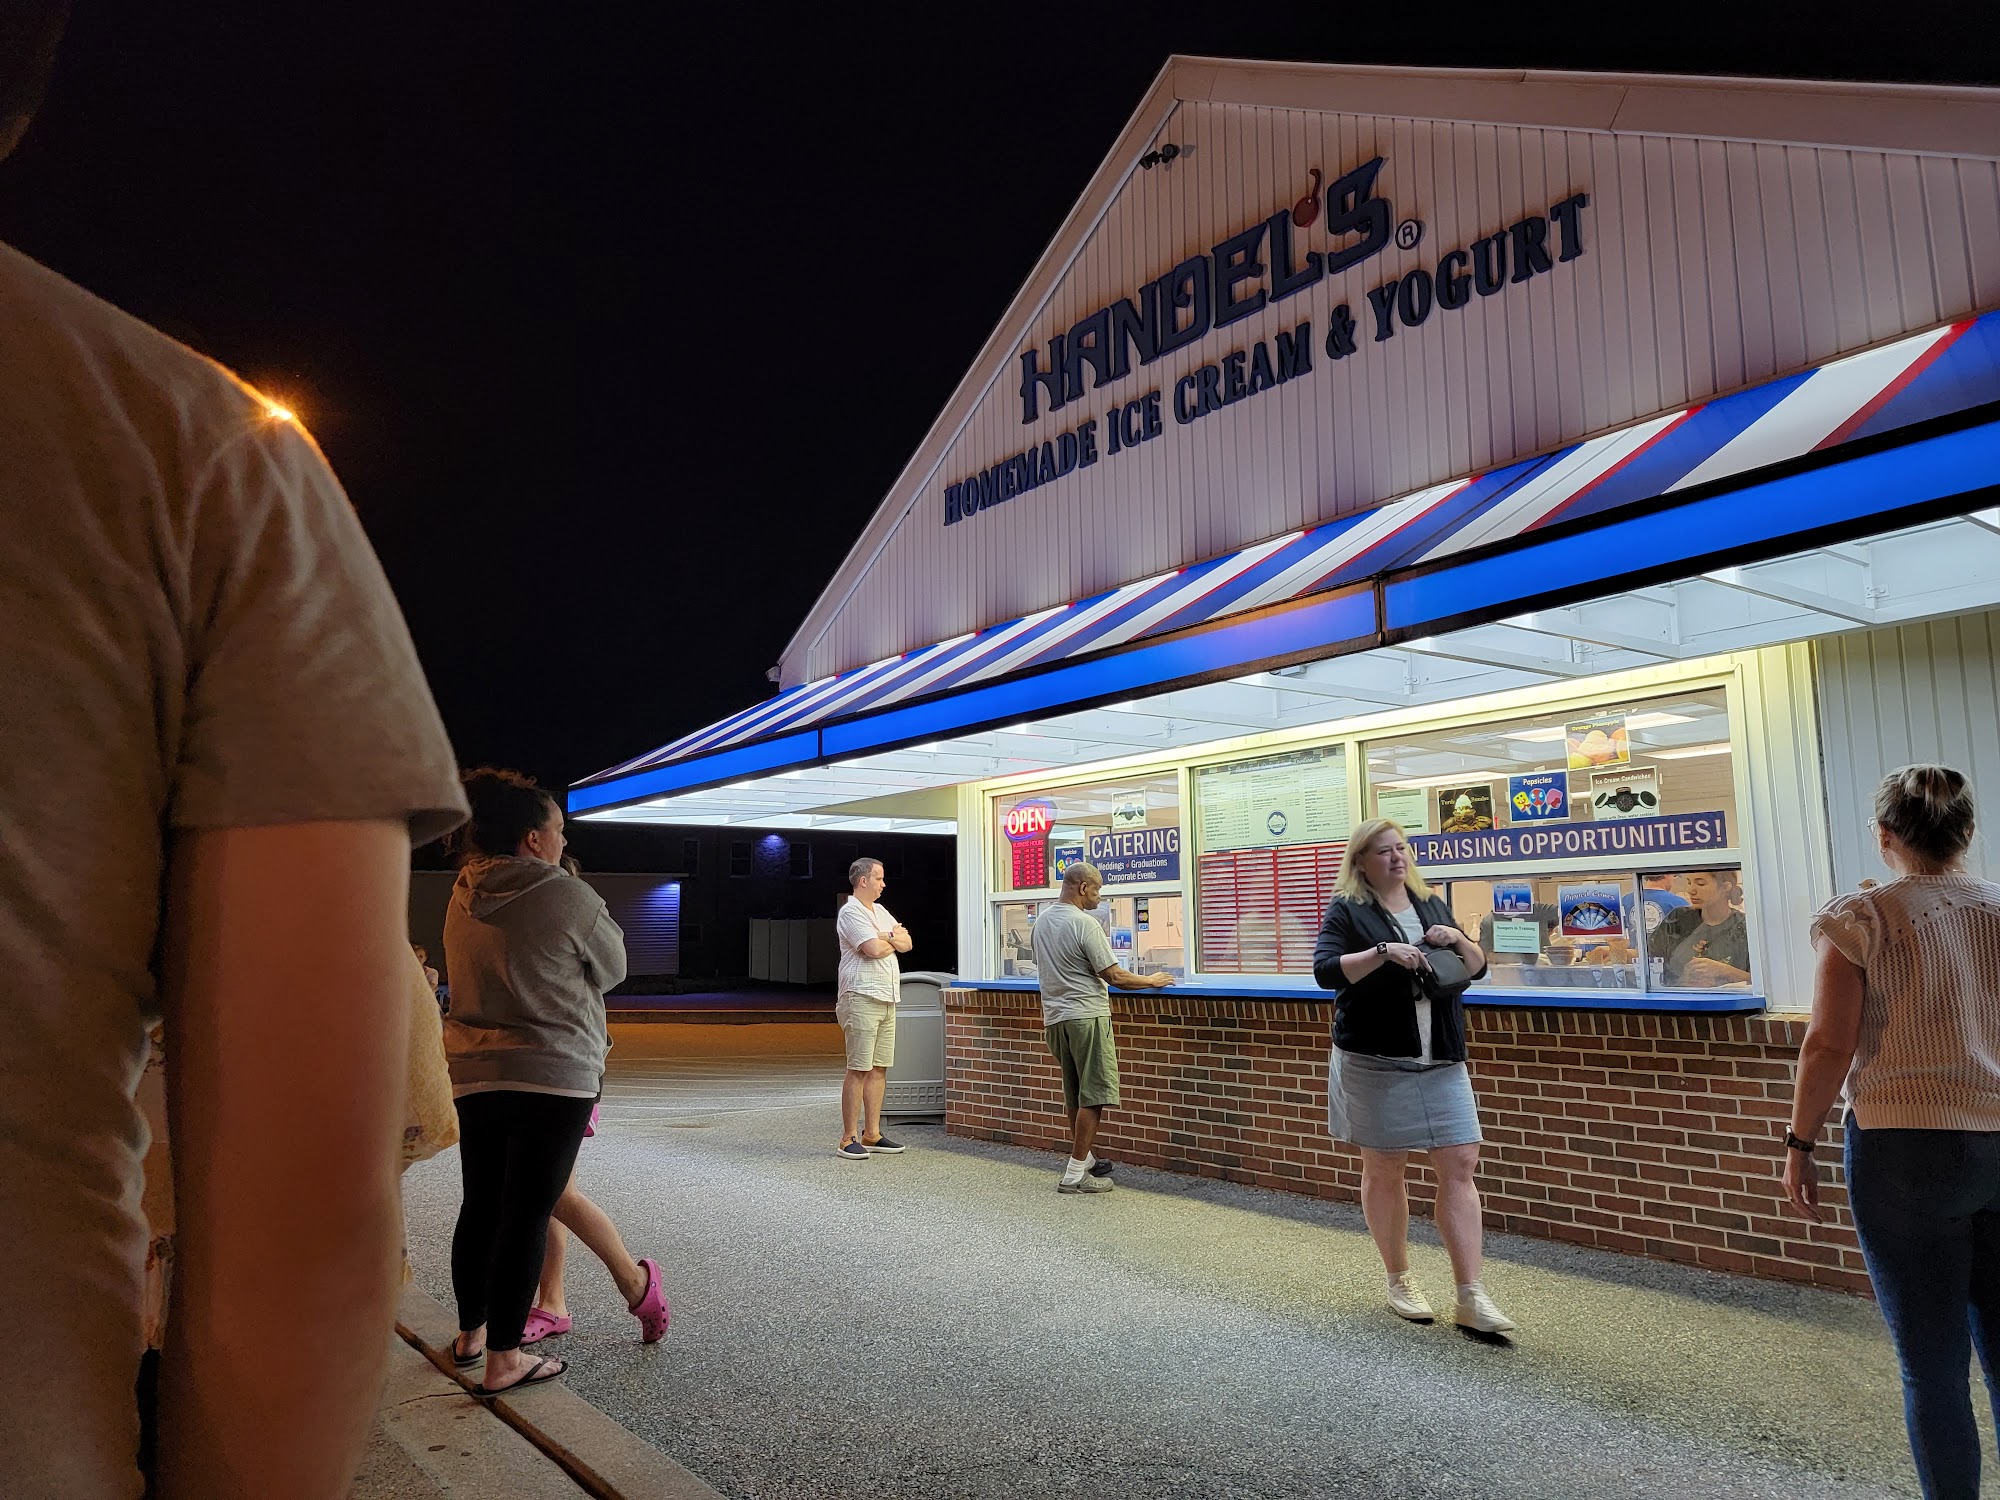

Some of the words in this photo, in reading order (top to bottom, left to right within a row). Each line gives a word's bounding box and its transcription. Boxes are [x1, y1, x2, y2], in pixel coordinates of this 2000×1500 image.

[1019, 156, 1391, 424] HANDEL'S
[943, 420, 1098, 526] HOMEMADE
[1106, 390, 1162, 455] ICE
[1173, 322, 1312, 425] CREAM
[1325, 304, 1356, 360] &
[1367, 193, 1588, 342] YOGURT
[1523, 776, 1553, 787] Popsicles
[1621, 773, 1651, 782] Sandwiches
[1007, 806, 1046, 835] OPEN
[1091, 829, 1179, 859] CATERING
[1519, 819, 1722, 856] OPPORTUNITIES!
[1097, 861, 1124, 871] Weddings
[1131, 858, 1168, 869] Graduations
[1108, 872, 1136, 882] Corporate
[1137, 871, 1157, 880] Events
[1564, 890, 1590, 902] Dipped
[1591, 890, 1616, 900] Cones
